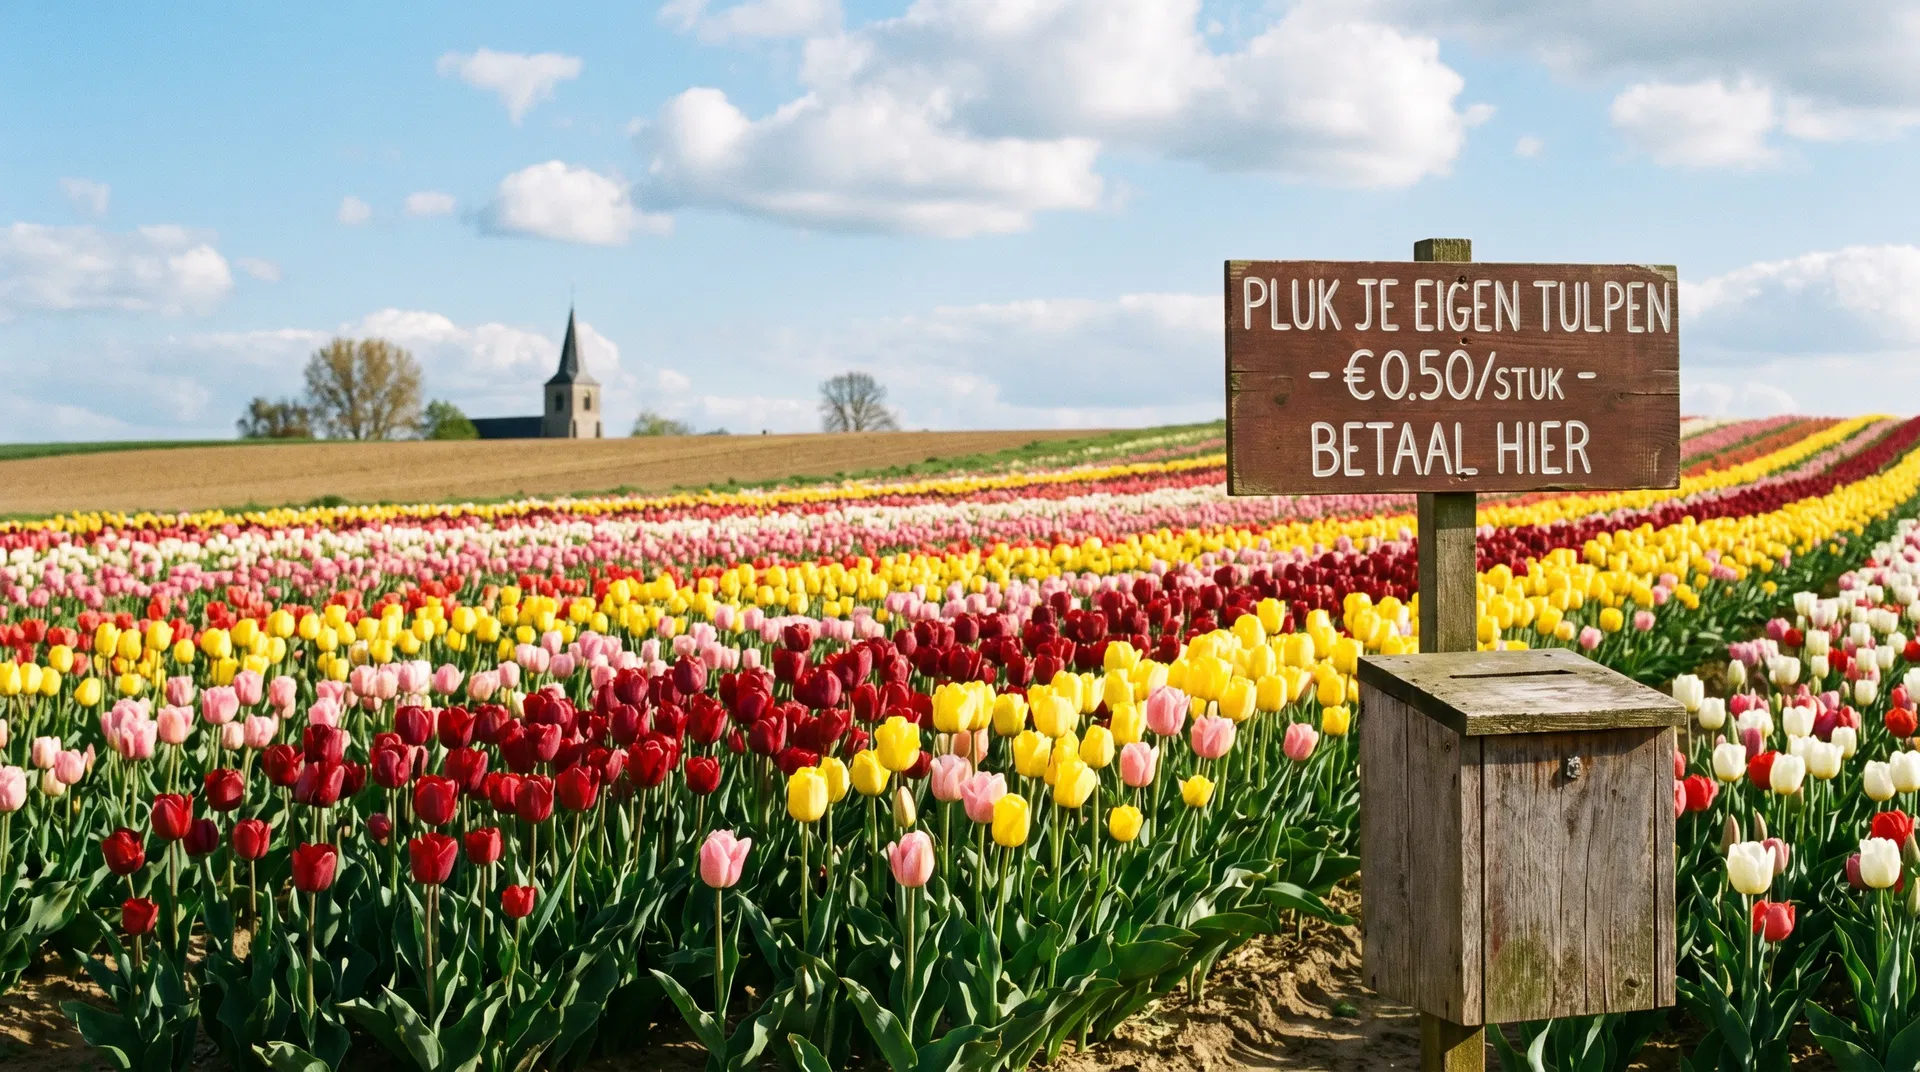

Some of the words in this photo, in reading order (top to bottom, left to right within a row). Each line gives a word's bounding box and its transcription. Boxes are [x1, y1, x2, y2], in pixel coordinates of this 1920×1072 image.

[1243, 276, 1342, 332] PLUK
[1354, 278, 1400, 332] JE
[1414, 279, 1521, 332] EIGEN
[1532, 280, 1671, 334] TULPEN
[1311, 421, 1479, 477] BETAAL
[1496, 420, 1592, 475] HIER
